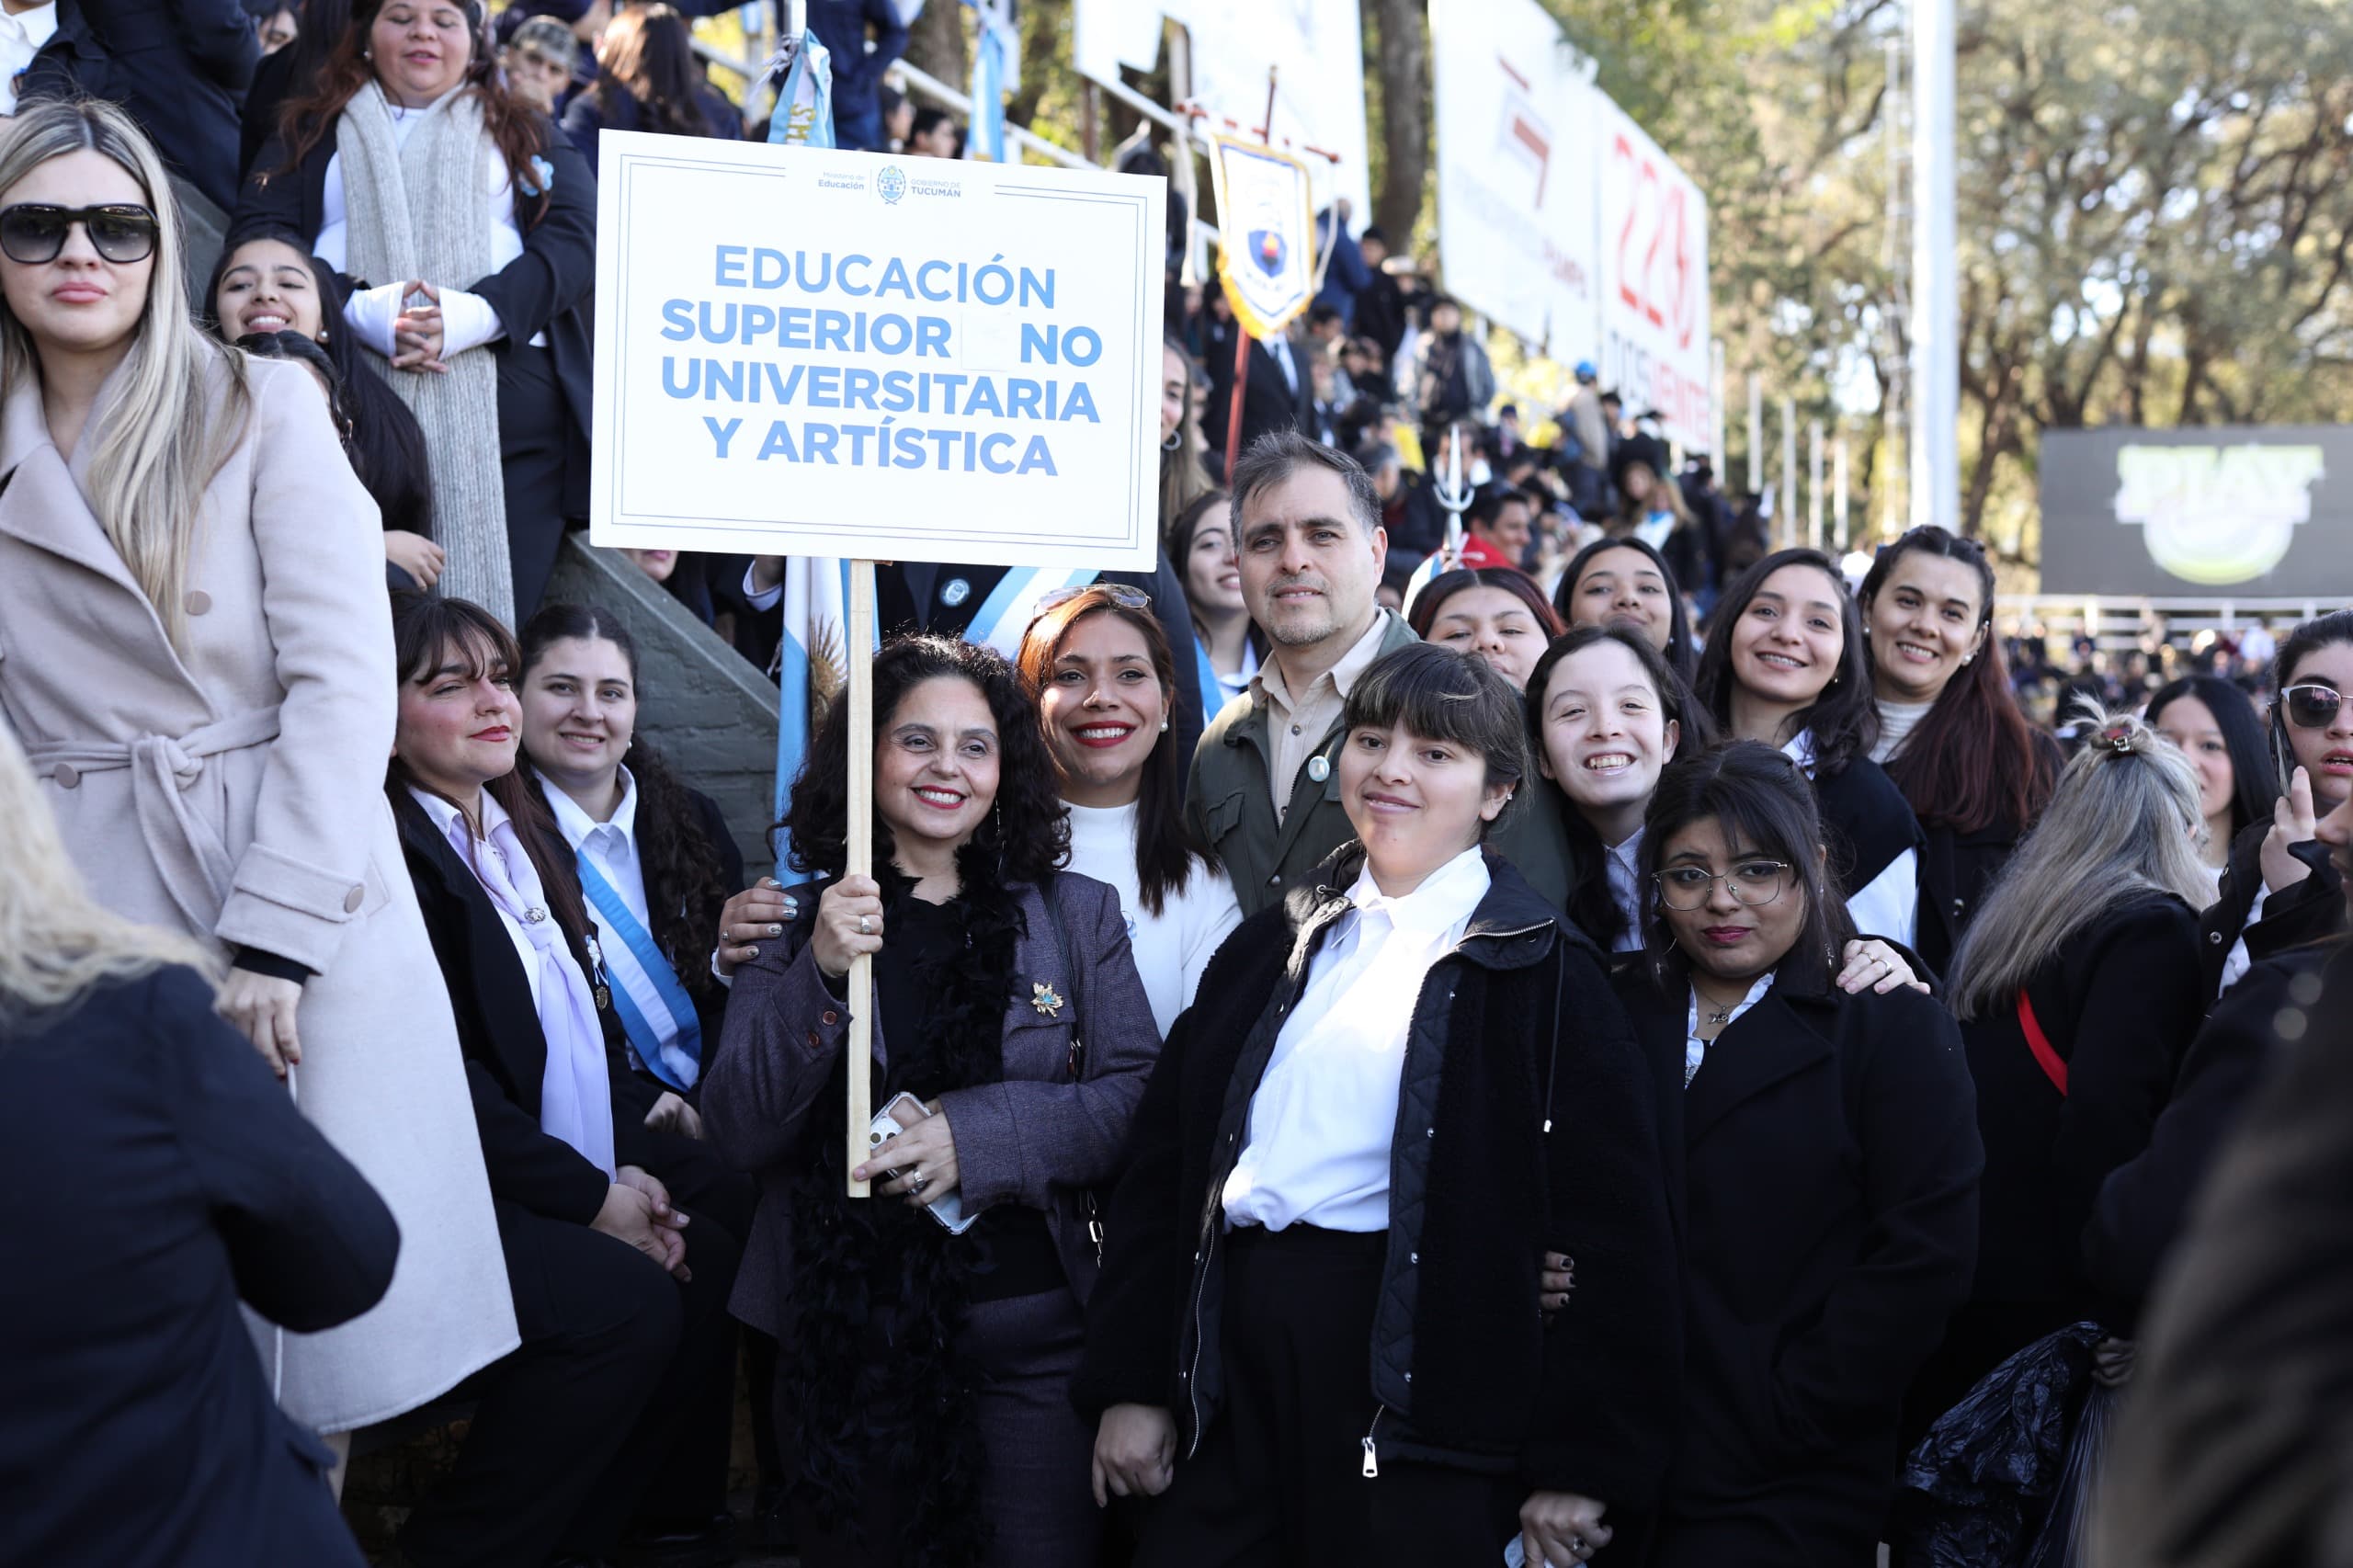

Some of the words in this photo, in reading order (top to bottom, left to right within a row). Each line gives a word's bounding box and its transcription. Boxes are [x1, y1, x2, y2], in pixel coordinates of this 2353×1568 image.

[818, 178, 865, 190] Educación
[911, 178, 949, 188] GOBIERNO
[911, 186, 961, 198] TUCUMÁN
[716, 245, 1054, 309] EDUCACIÓN
[662, 300, 951, 358] SUPERIOR
[1021, 324, 1102, 367] NO
[663, 357, 1100, 423] UNIVERSITARIA
[704, 417, 742, 458] Y
[757, 416, 1057, 476] ARTÍSTICA
